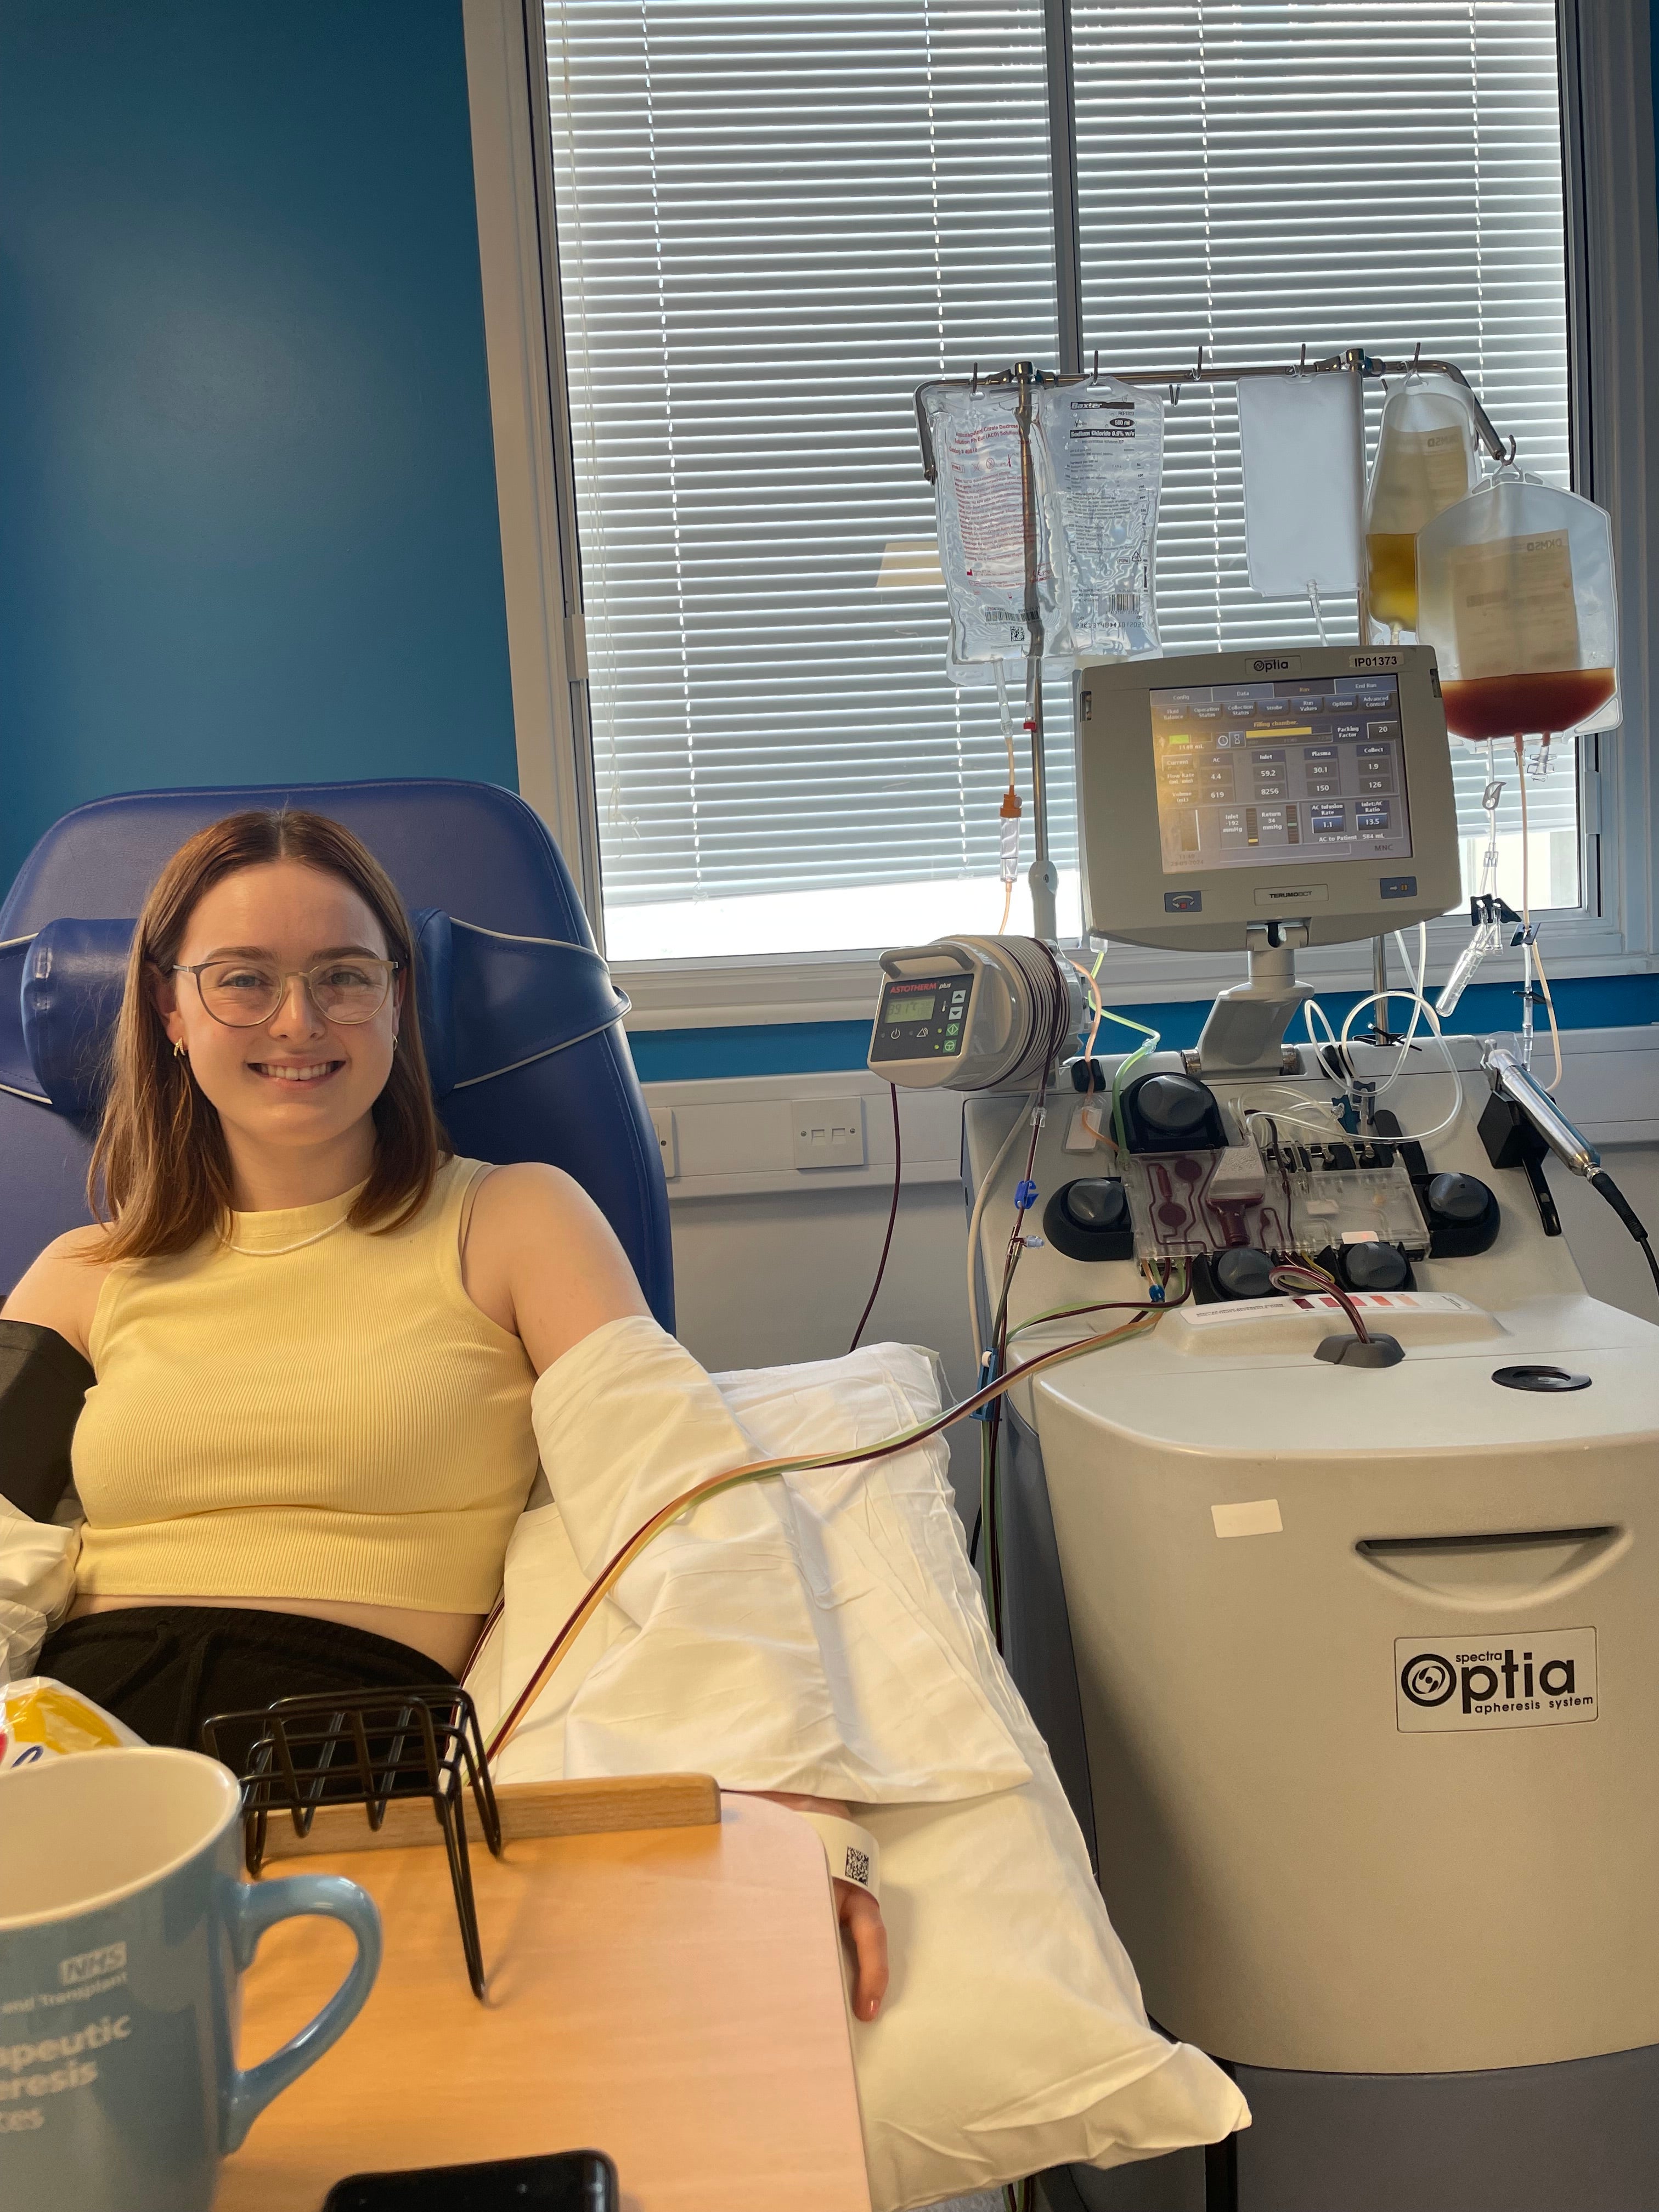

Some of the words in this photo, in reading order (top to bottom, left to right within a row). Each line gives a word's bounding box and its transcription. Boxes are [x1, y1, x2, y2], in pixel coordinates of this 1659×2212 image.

[1254, 659, 1289, 673] Optia
[1355, 656, 1397, 667] IP01373
[1268, 890, 1313, 899] TERUMOBCT
[889, 983, 937, 994] ASTOTHERM
[1455, 1651, 1503, 1664] spectra
[1401, 1649, 1576, 1714] Optia
[1475, 1700, 1541, 1716] apheresis
[1549, 1696, 1594, 1710] system
[65, 1950, 124, 1978] NHS
[36, 1971, 128, 2007] Transplant
